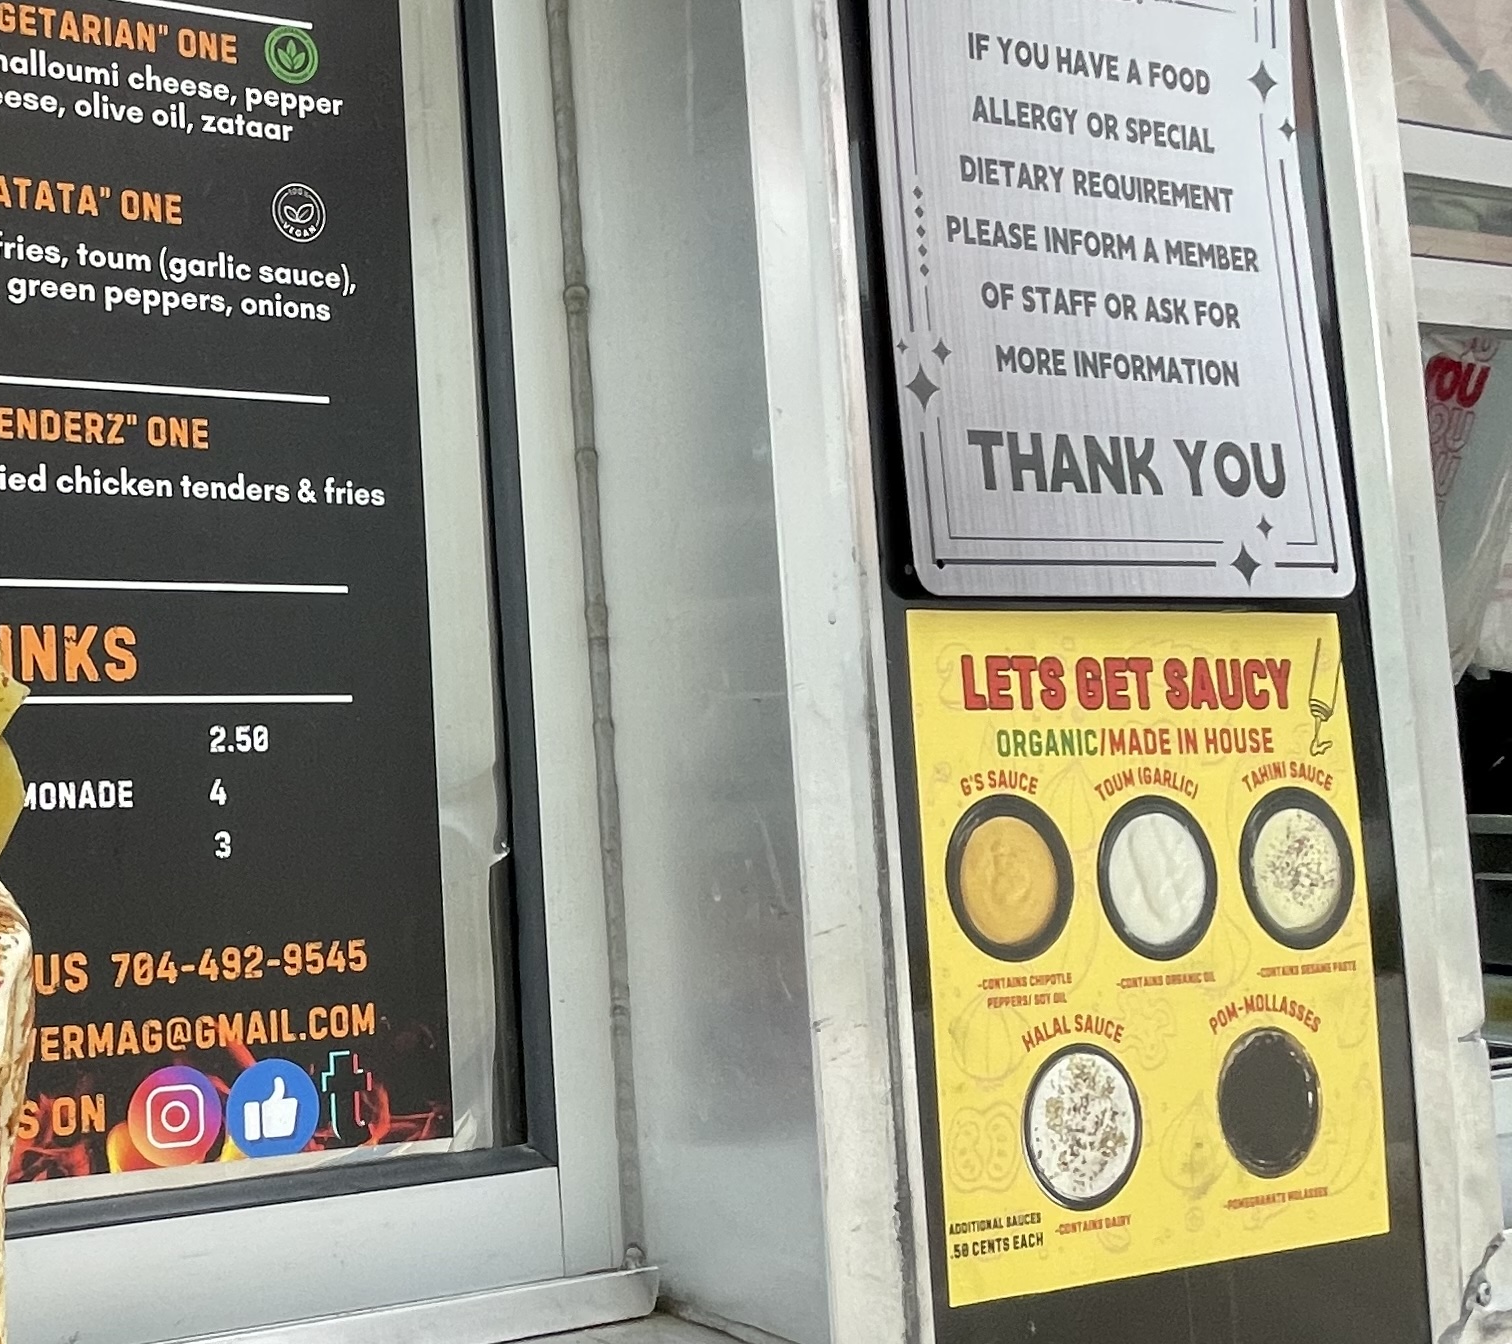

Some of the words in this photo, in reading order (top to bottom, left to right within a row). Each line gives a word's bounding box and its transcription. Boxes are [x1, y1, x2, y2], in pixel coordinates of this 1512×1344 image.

[177, 27, 238, 65] ONE
[967, 31, 990, 61] IF
[996, 36, 1049, 70] YOU
[1055, 46, 1120, 82] HAVE
[1126, 58, 1143, 86] A
[1148, 61, 1211, 96] FOOD
[127, 63, 238, 107] cheese,
[244, 87, 344, 119] pepper
[972, 95, 1078, 136] ALLERGY
[1086, 111, 1120, 142] OR
[1125, 117, 1216, 155] SPECIAL
[959, 154, 1065, 193] DIETARY
[1072, 168, 1234, 214] REQUIREMENT
[120, 189, 183, 225] ONE
[283, 221, 316, 237] VEGAN
[945, 214, 1038, 252] PLEASE
[1043, 225, 1137, 262] INFORM
[1143, 236, 1160, 264] A
[1164, 238, 1260, 273] MEMBER
[981, 281, 1014, 311] OF
[1021, 285, 1097, 318] STAFF
[1104, 292, 1138, 322] OR
[1144, 296, 1190, 326] ASK
[1193, 300, 1241, 329] FOR
[995, 344, 1068, 377] MORE
[1073, 350, 1240, 388] INFORMATION
[147, 415, 209, 450] ONE
[966, 429, 1164, 496] THANK
[1172, 438, 1287, 499] YOU
[56, 464, 173, 498] chicken
[179, 472, 290, 503] tenders
[297, 477, 318, 504] &
[323, 476, 386, 507] fries
[961, 655, 1067, 711] LETS
[1076, 657, 1153, 710] GET
[1164, 657, 1290, 711] SAUCY
[209, 724, 269, 753] 2.50
[996, 728, 1170, 757] ORGANIC/MADE
[1178, 729, 1198, 755] IN
[1205, 727, 1274, 754] HOUSE
[209, 778, 228, 806] 4
[961, 773, 984, 797] G'S
[988, 770, 1039, 795] SAUCE
[1094, 768, 1134, 801] TOUM
[1242, 761, 1286, 793] TAHINI
[1290, 761, 1334, 791] SAUCE
[214, 830, 232, 859] 3
[111, 939, 368, 988] 704-492-9545
[29, 1003, 374, 1063] ERMAG@GMAIL.COM
[1021, 1015, 1071, 1052] HALAL
[1075, 1014, 1125, 1044] SAUCE
[1209, 994, 1321, 1035] POM-MOLLASSES
[52, 1094, 105, 1136] ON
[949, 1218, 1003, 1235] ADDITIONAL
[1006, 1212, 1041, 1228] SAUCES
[950, 1243, 969, 1259] .50
[972, 1237, 1010, 1256] CENTS
[1013, 1232, 1043, 1250] EACH
